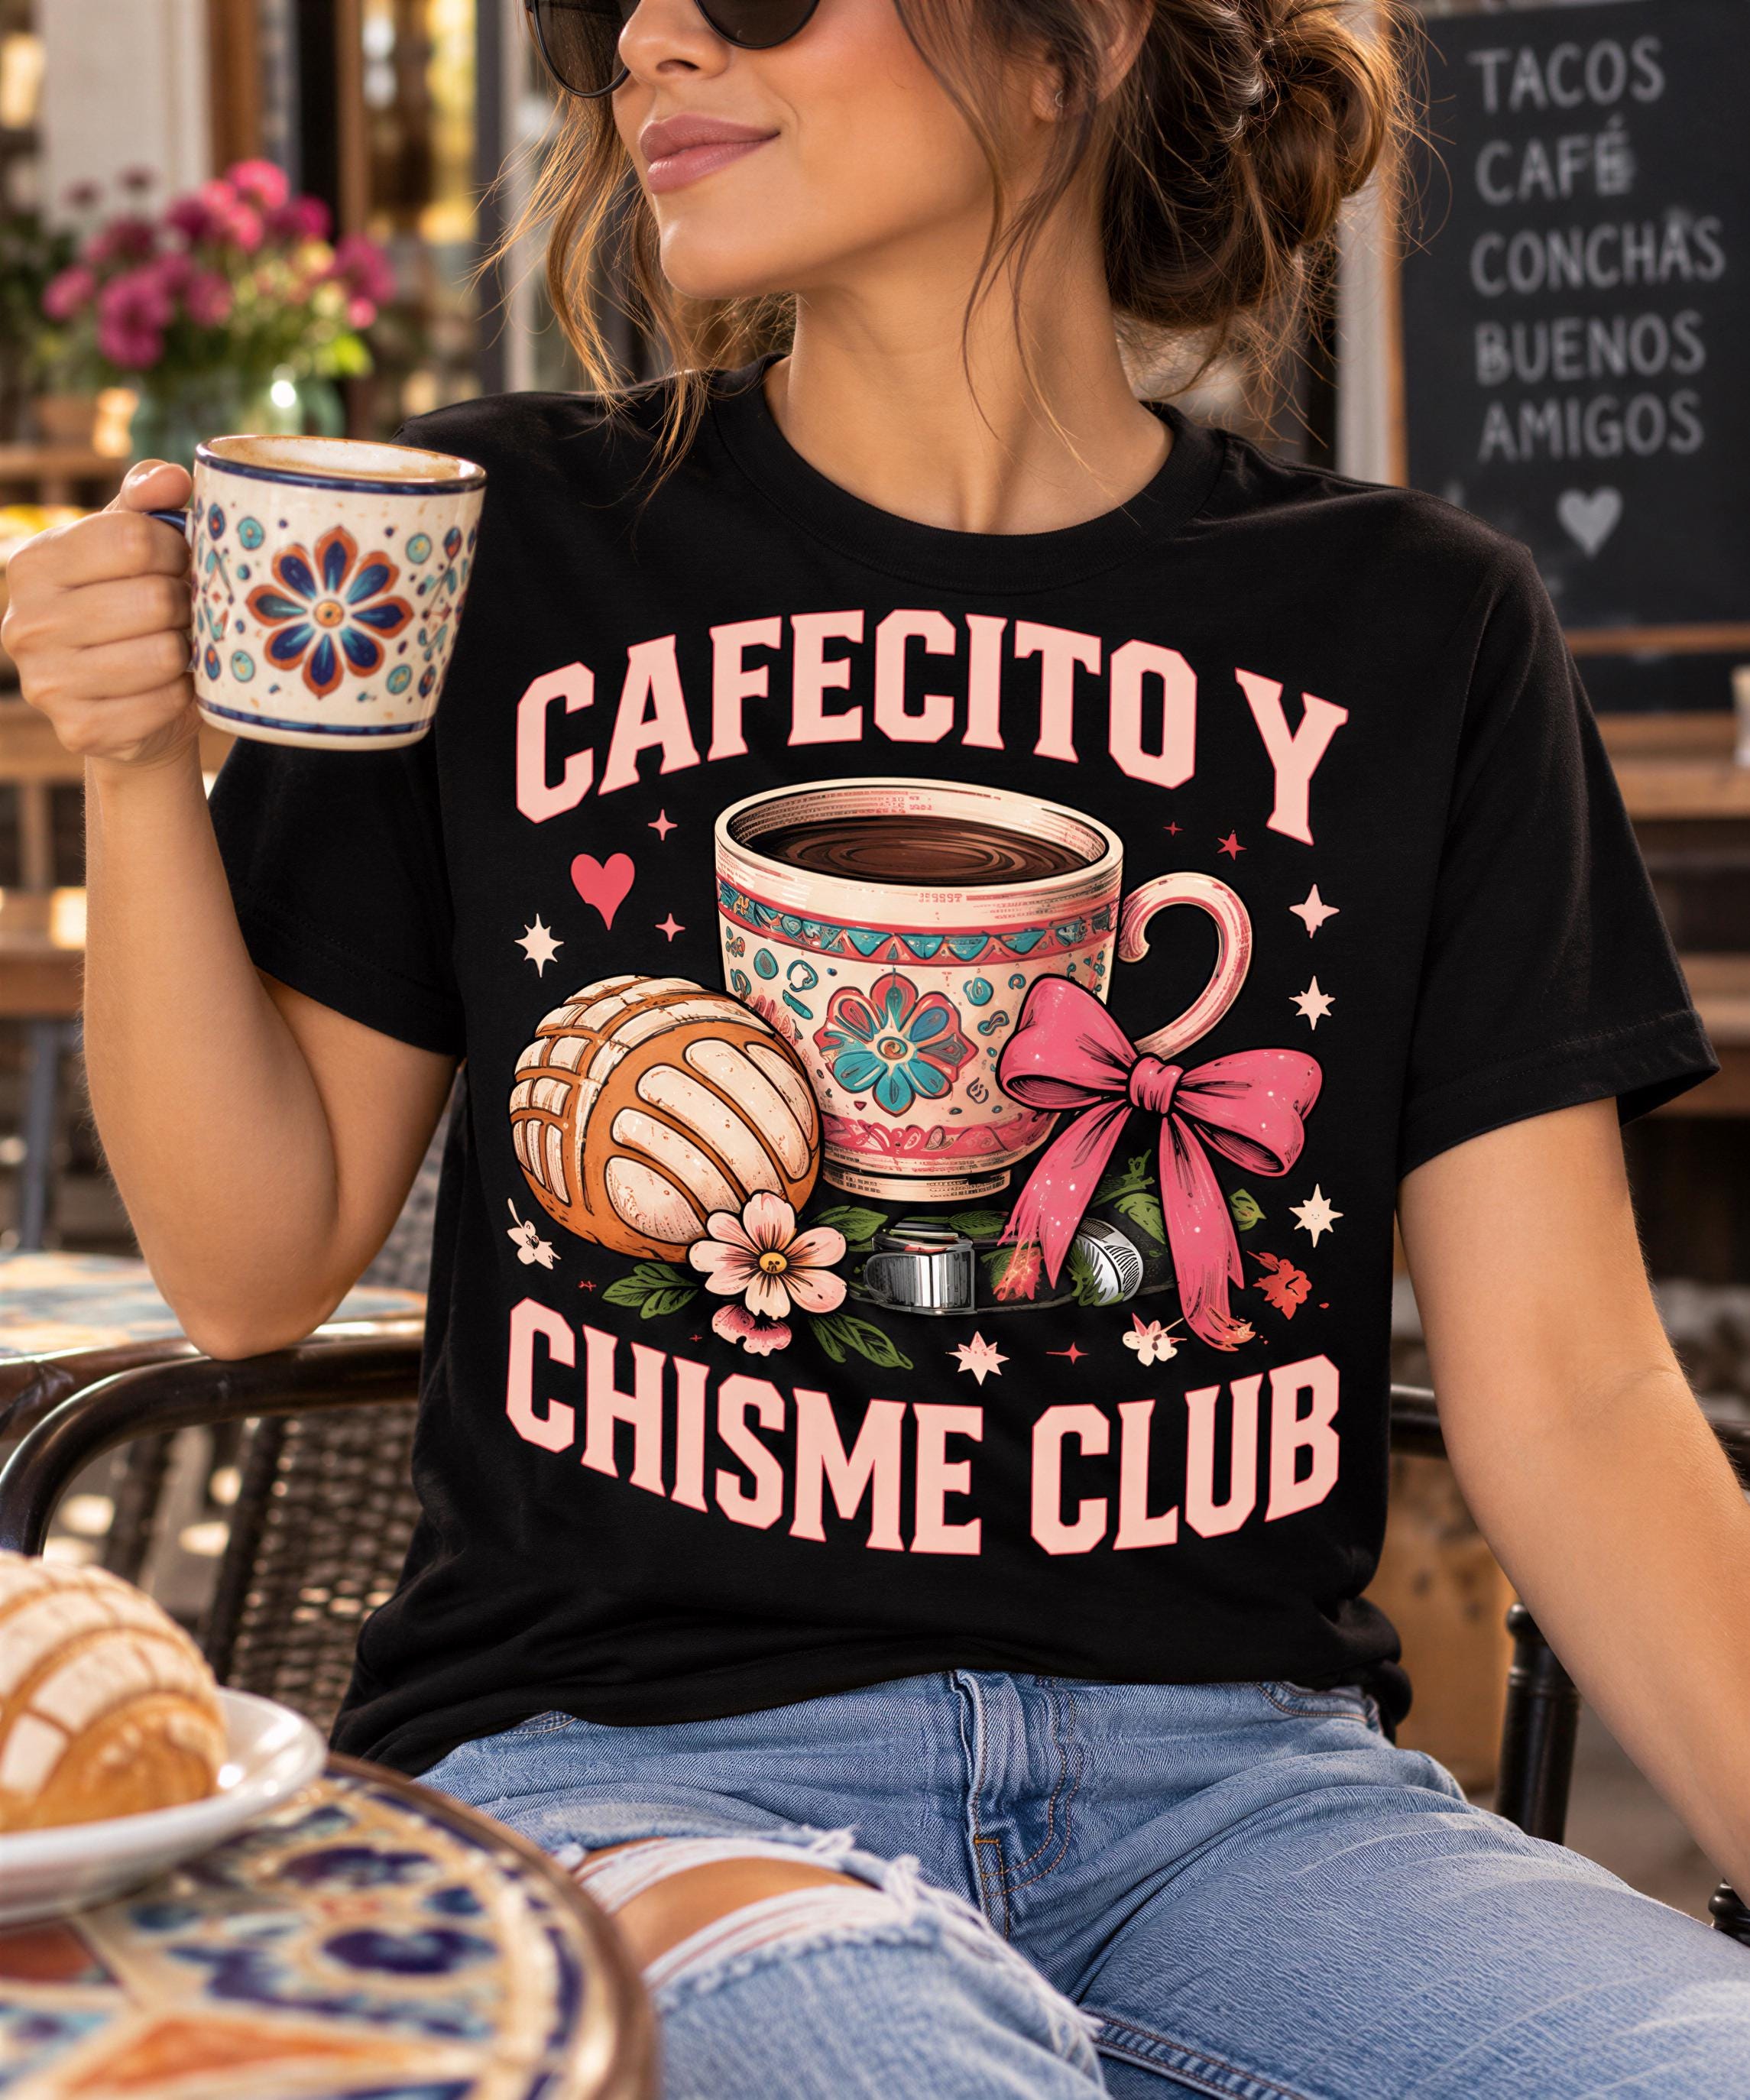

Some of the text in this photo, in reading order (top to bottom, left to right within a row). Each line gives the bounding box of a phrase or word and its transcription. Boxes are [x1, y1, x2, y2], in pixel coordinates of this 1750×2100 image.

[1467, 35, 1666, 114] TACOS
[1474, 309, 1706, 384] BUENOS
[1479, 388, 1704, 462] AMIGOS
[517, 609, 1349, 847] CAFECITO Y
[506, 1297, 1340, 1555] CHISME CLUB
